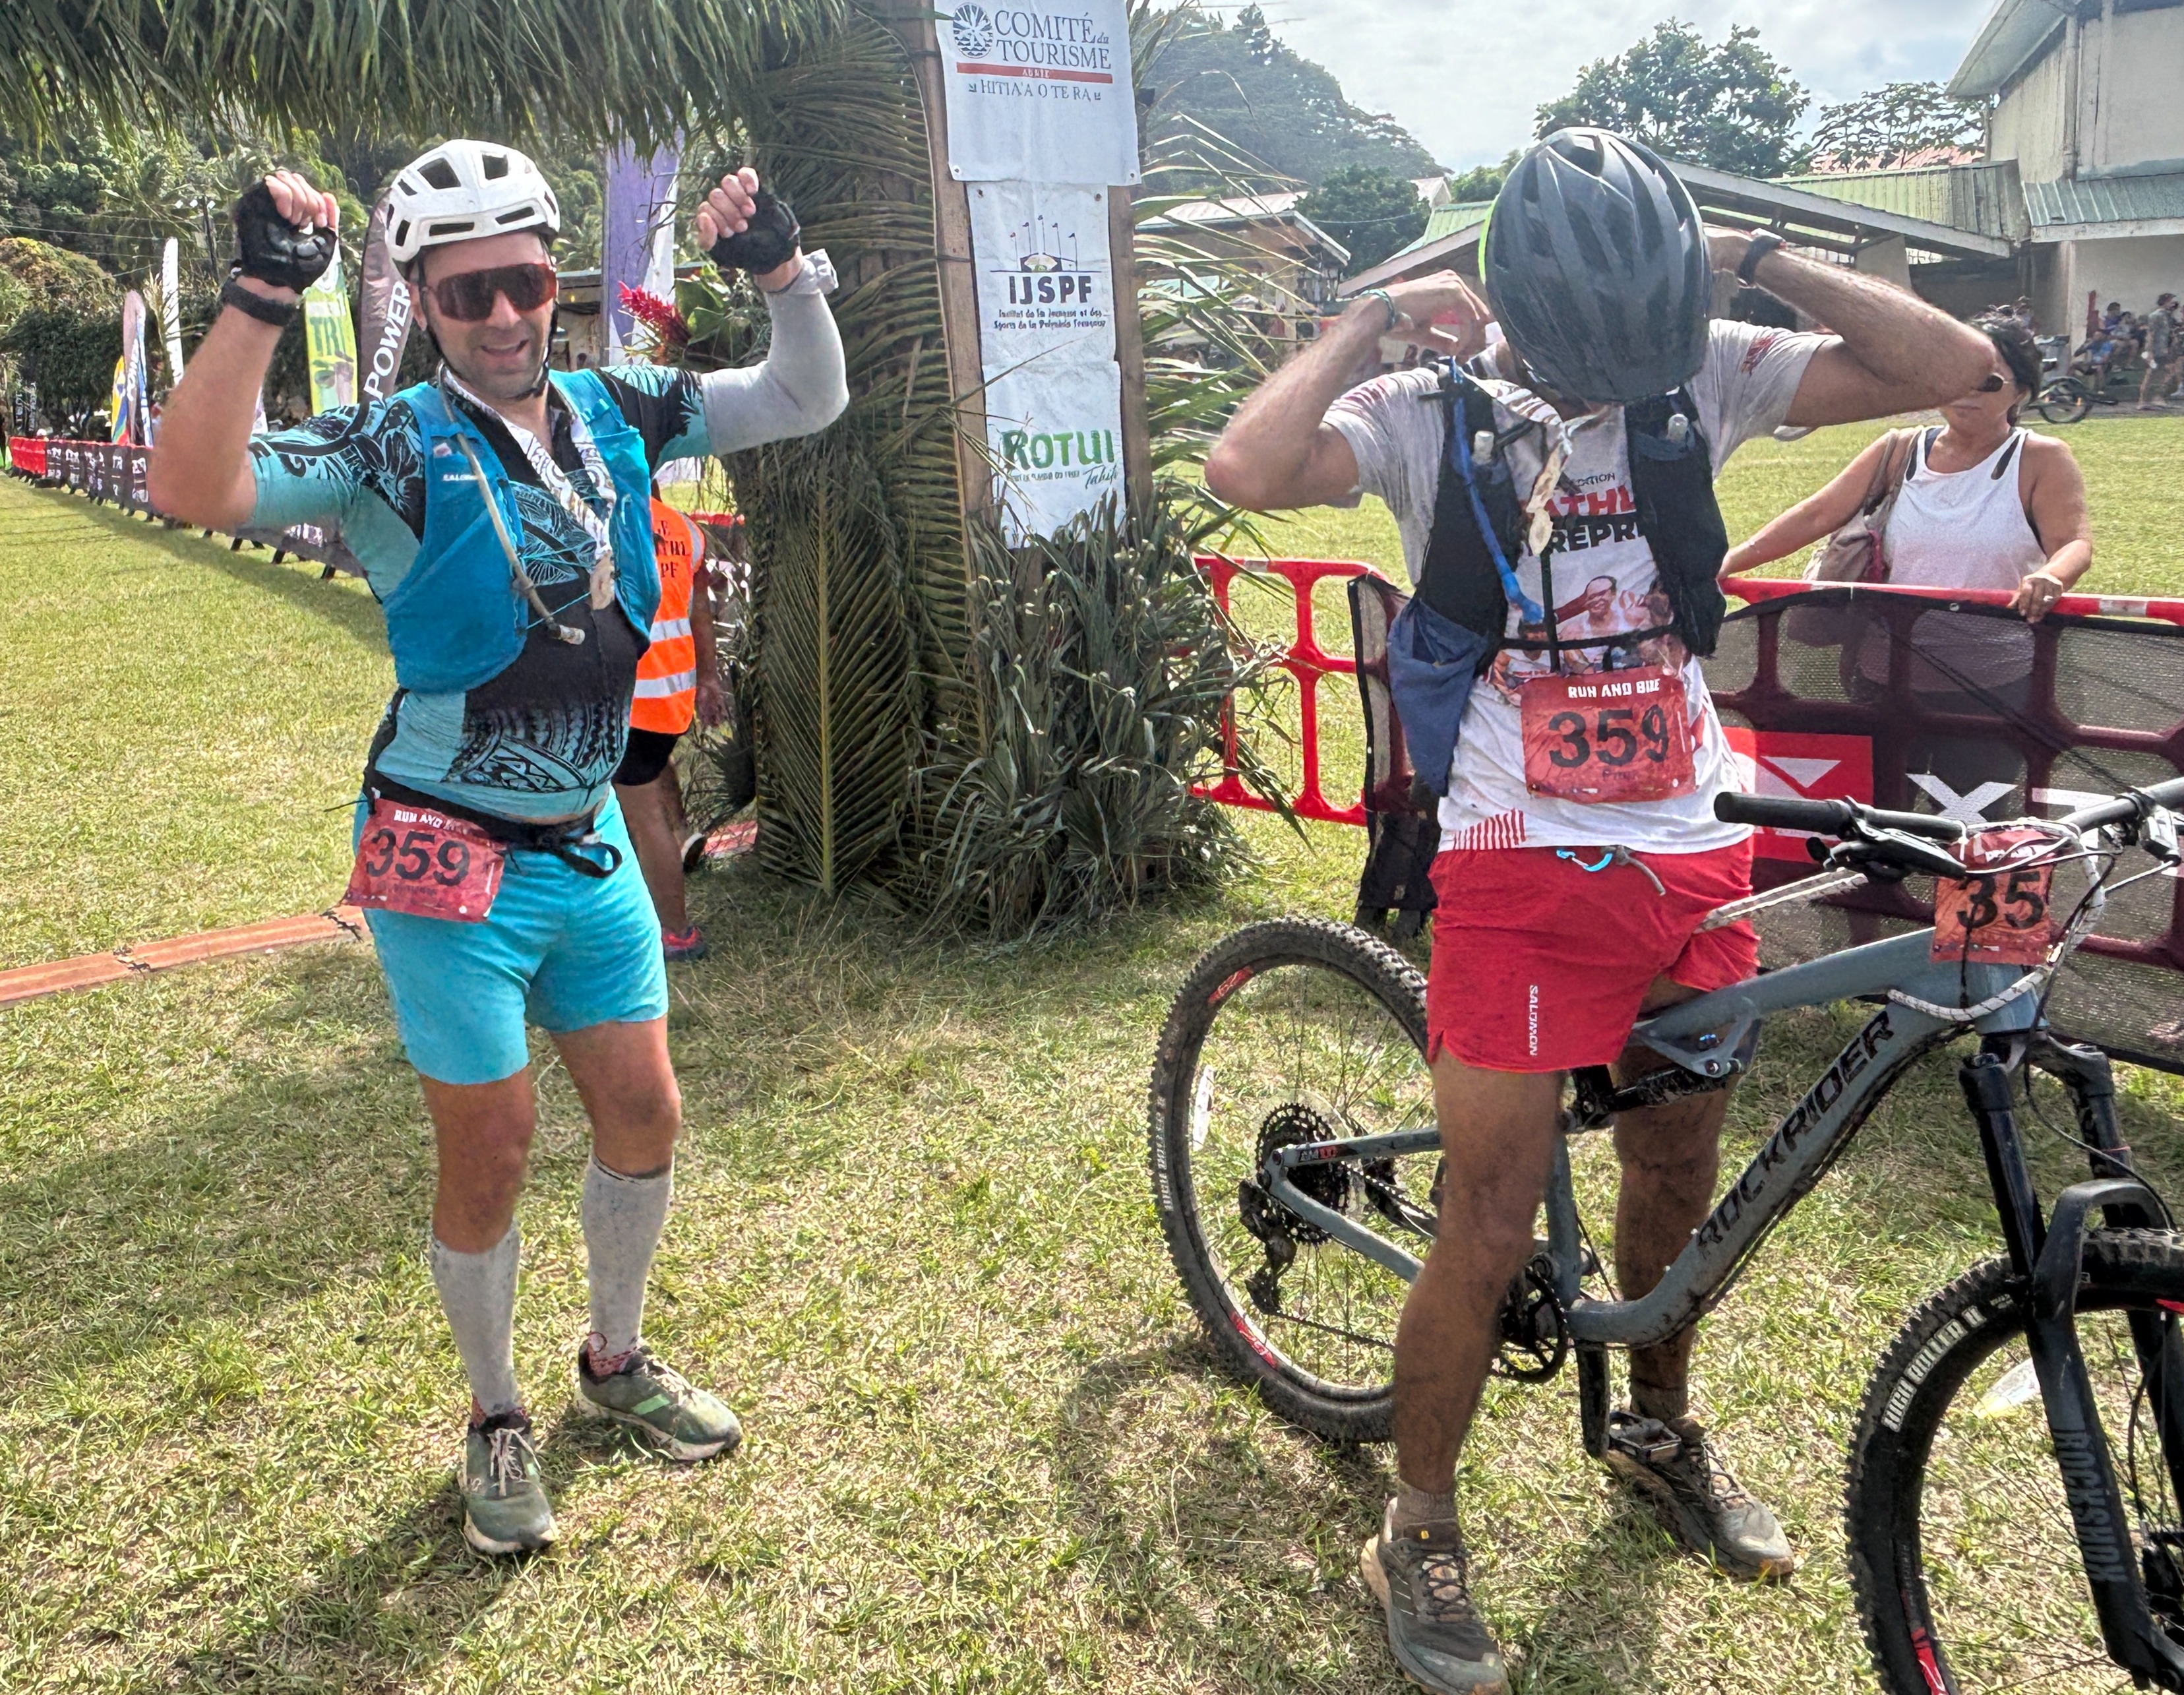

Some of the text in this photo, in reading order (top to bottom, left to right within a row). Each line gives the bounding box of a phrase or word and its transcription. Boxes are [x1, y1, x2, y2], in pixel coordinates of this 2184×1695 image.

[995, 10, 1096, 44] COMITÉ
[996, 40, 1112, 70] TOURISME
[1009, 276, 1092, 304] IJSPF
[363, 281, 411, 409] POWER
[1001, 429, 1114, 470] ROTUI
[1568, 686, 1596, 698] RUN
[1602, 683, 1632, 697] AND
[1549, 704, 1669, 768] 359
[394, 809, 417, 822] RUN
[367, 828, 470, 886] 359
[1529, 985, 1538, 1055] SALOMON
[1697, 1010, 1895, 1260] ROCKRIDER
[1904, 1318, 1968, 1384] ROLLER
